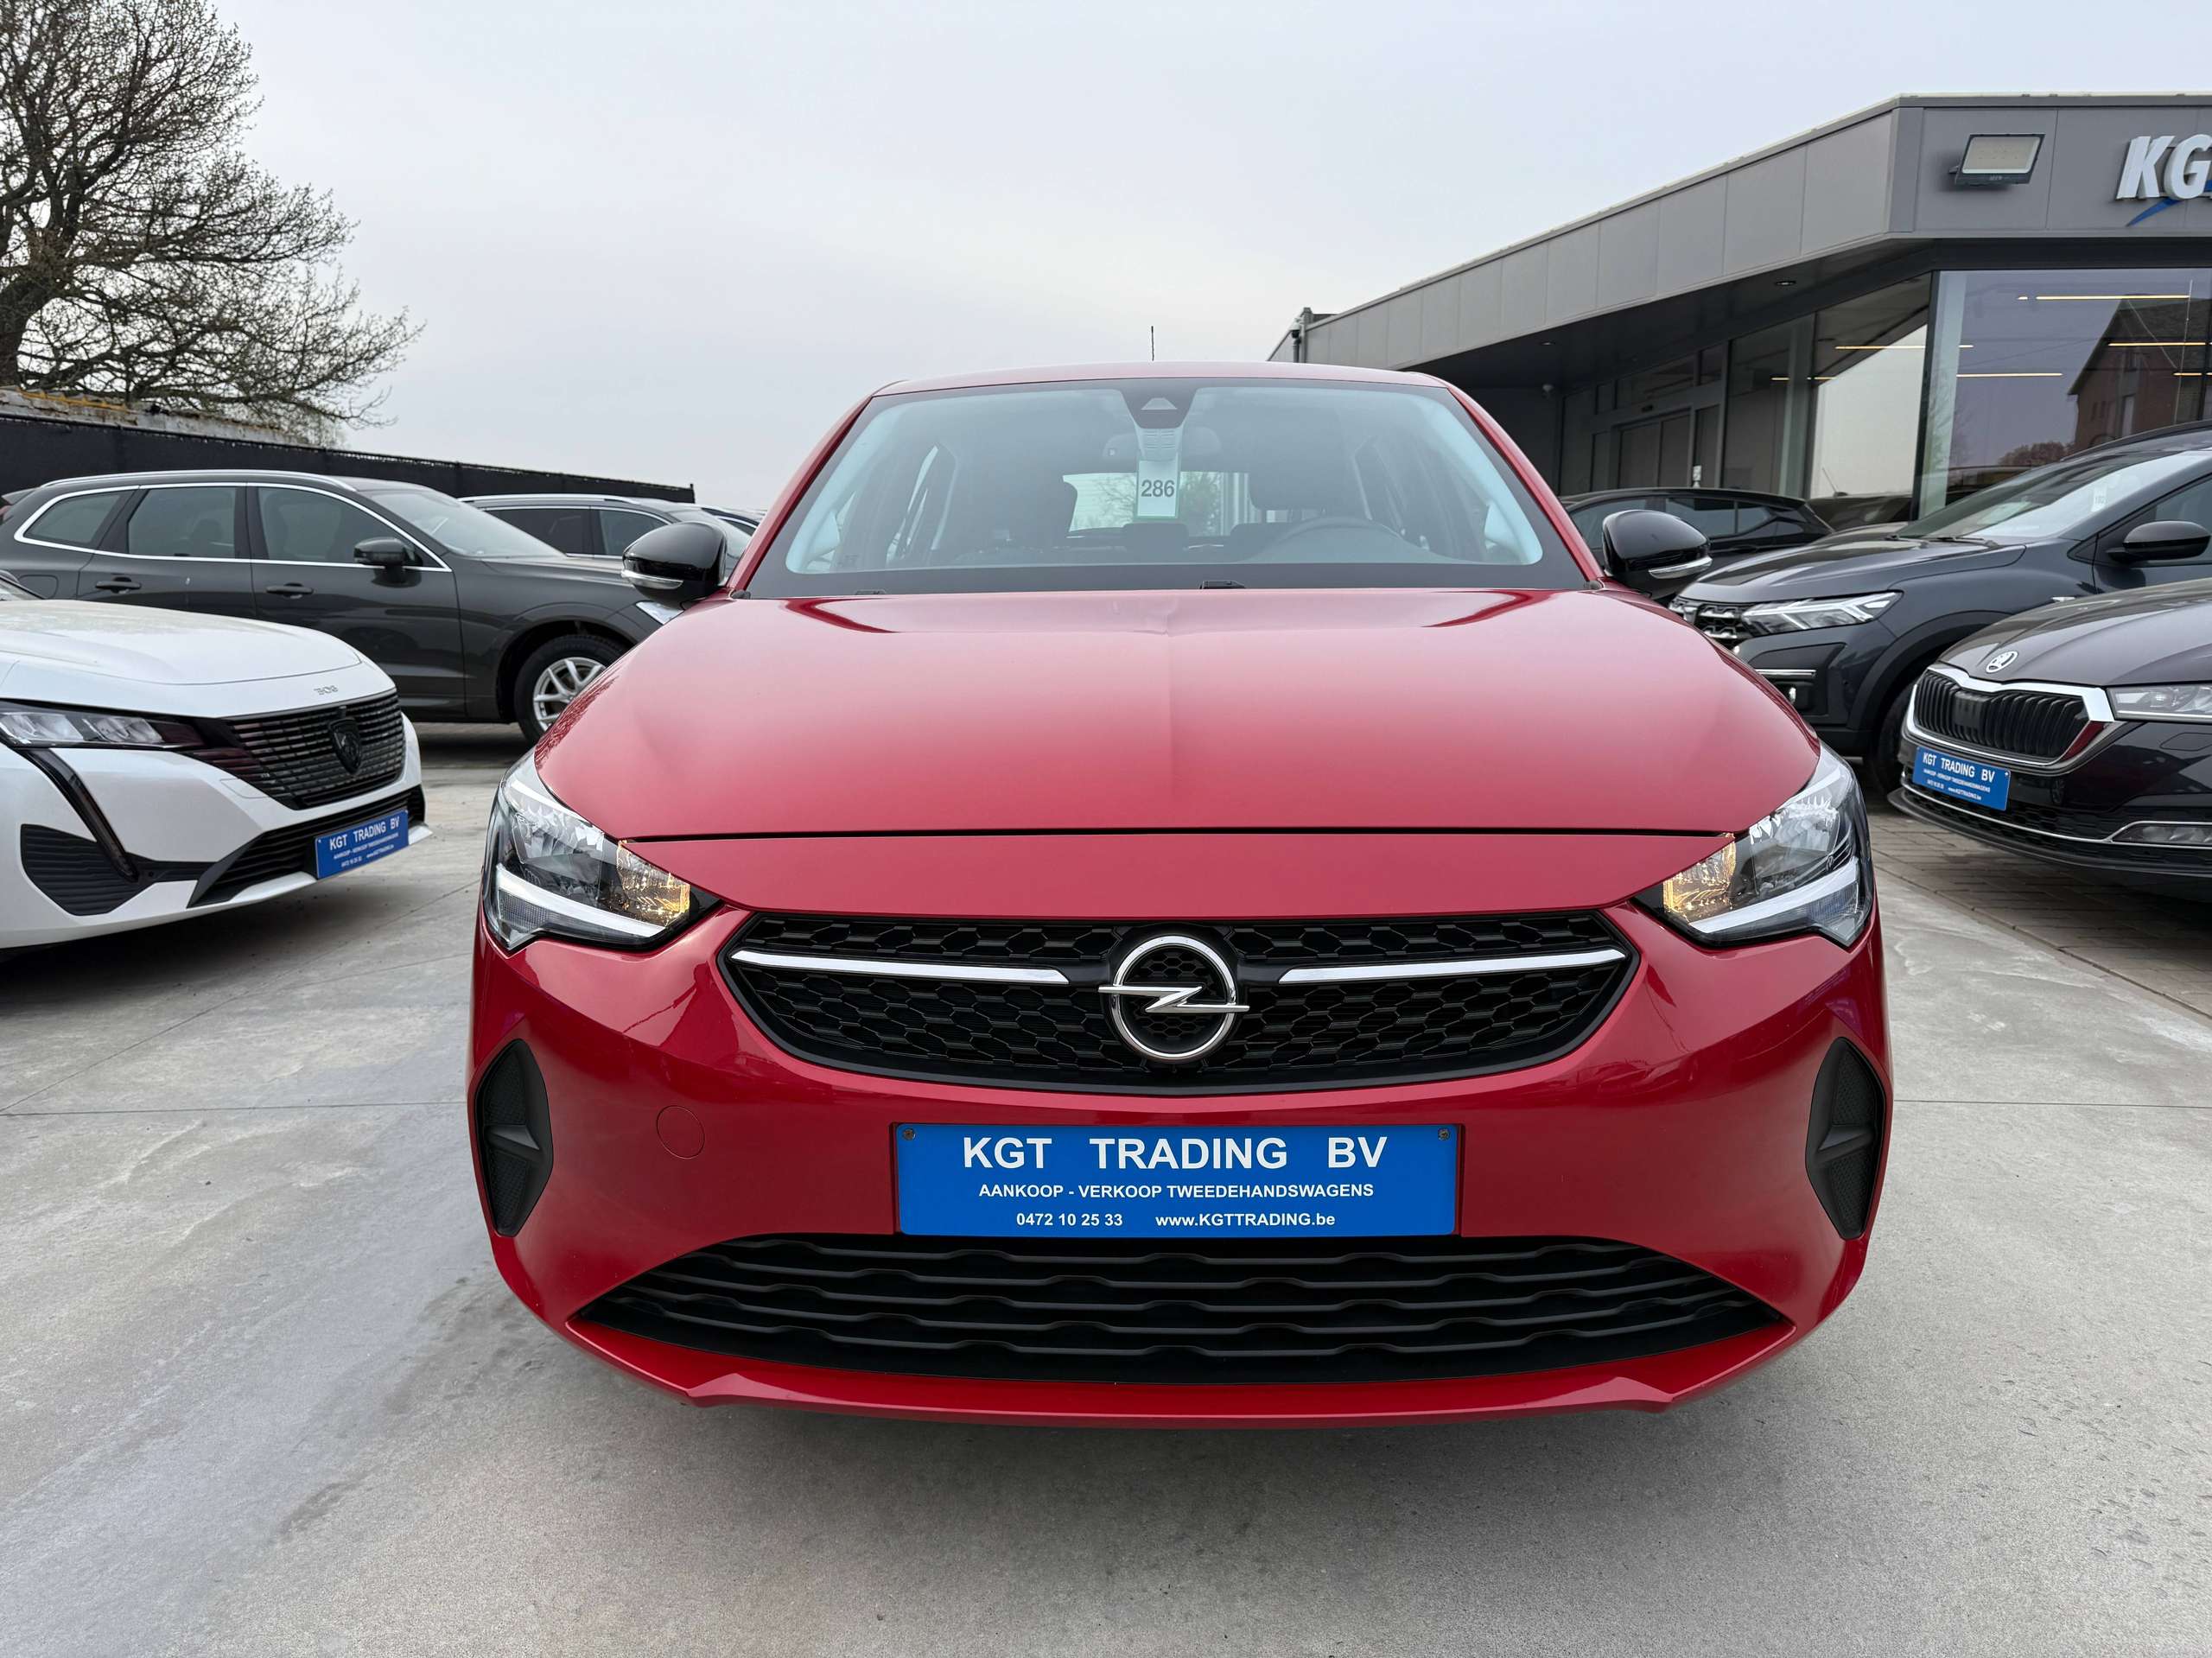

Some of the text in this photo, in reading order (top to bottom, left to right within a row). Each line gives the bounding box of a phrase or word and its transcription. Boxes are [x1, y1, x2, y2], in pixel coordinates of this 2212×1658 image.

[2116, 134, 2212, 200] KG
[1141, 480, 1175, 498] 286
[1923, 753, 1937, 766] KGT
[1941, 758, 1975, 778] TRADING
[1981, 769, 1995, 783] BV
[329, 834, 347, 851] KGT
[353, 821, 386, 842] TRADING
[390, 816, 400, 829] BV
[963, 1136, 1388, 1170] KGT TRADING BV
[979, 1184, 1064, 1198] AANKOOP
[1078, 1185, 1162, 1199] VERKOOP
[1166, 1184, 1374, 1199] TWEEDEHANDSWAGENS
[1016, 1212, 1336, 1227] 0472 10 25 33 www.KGTTRADING.be
